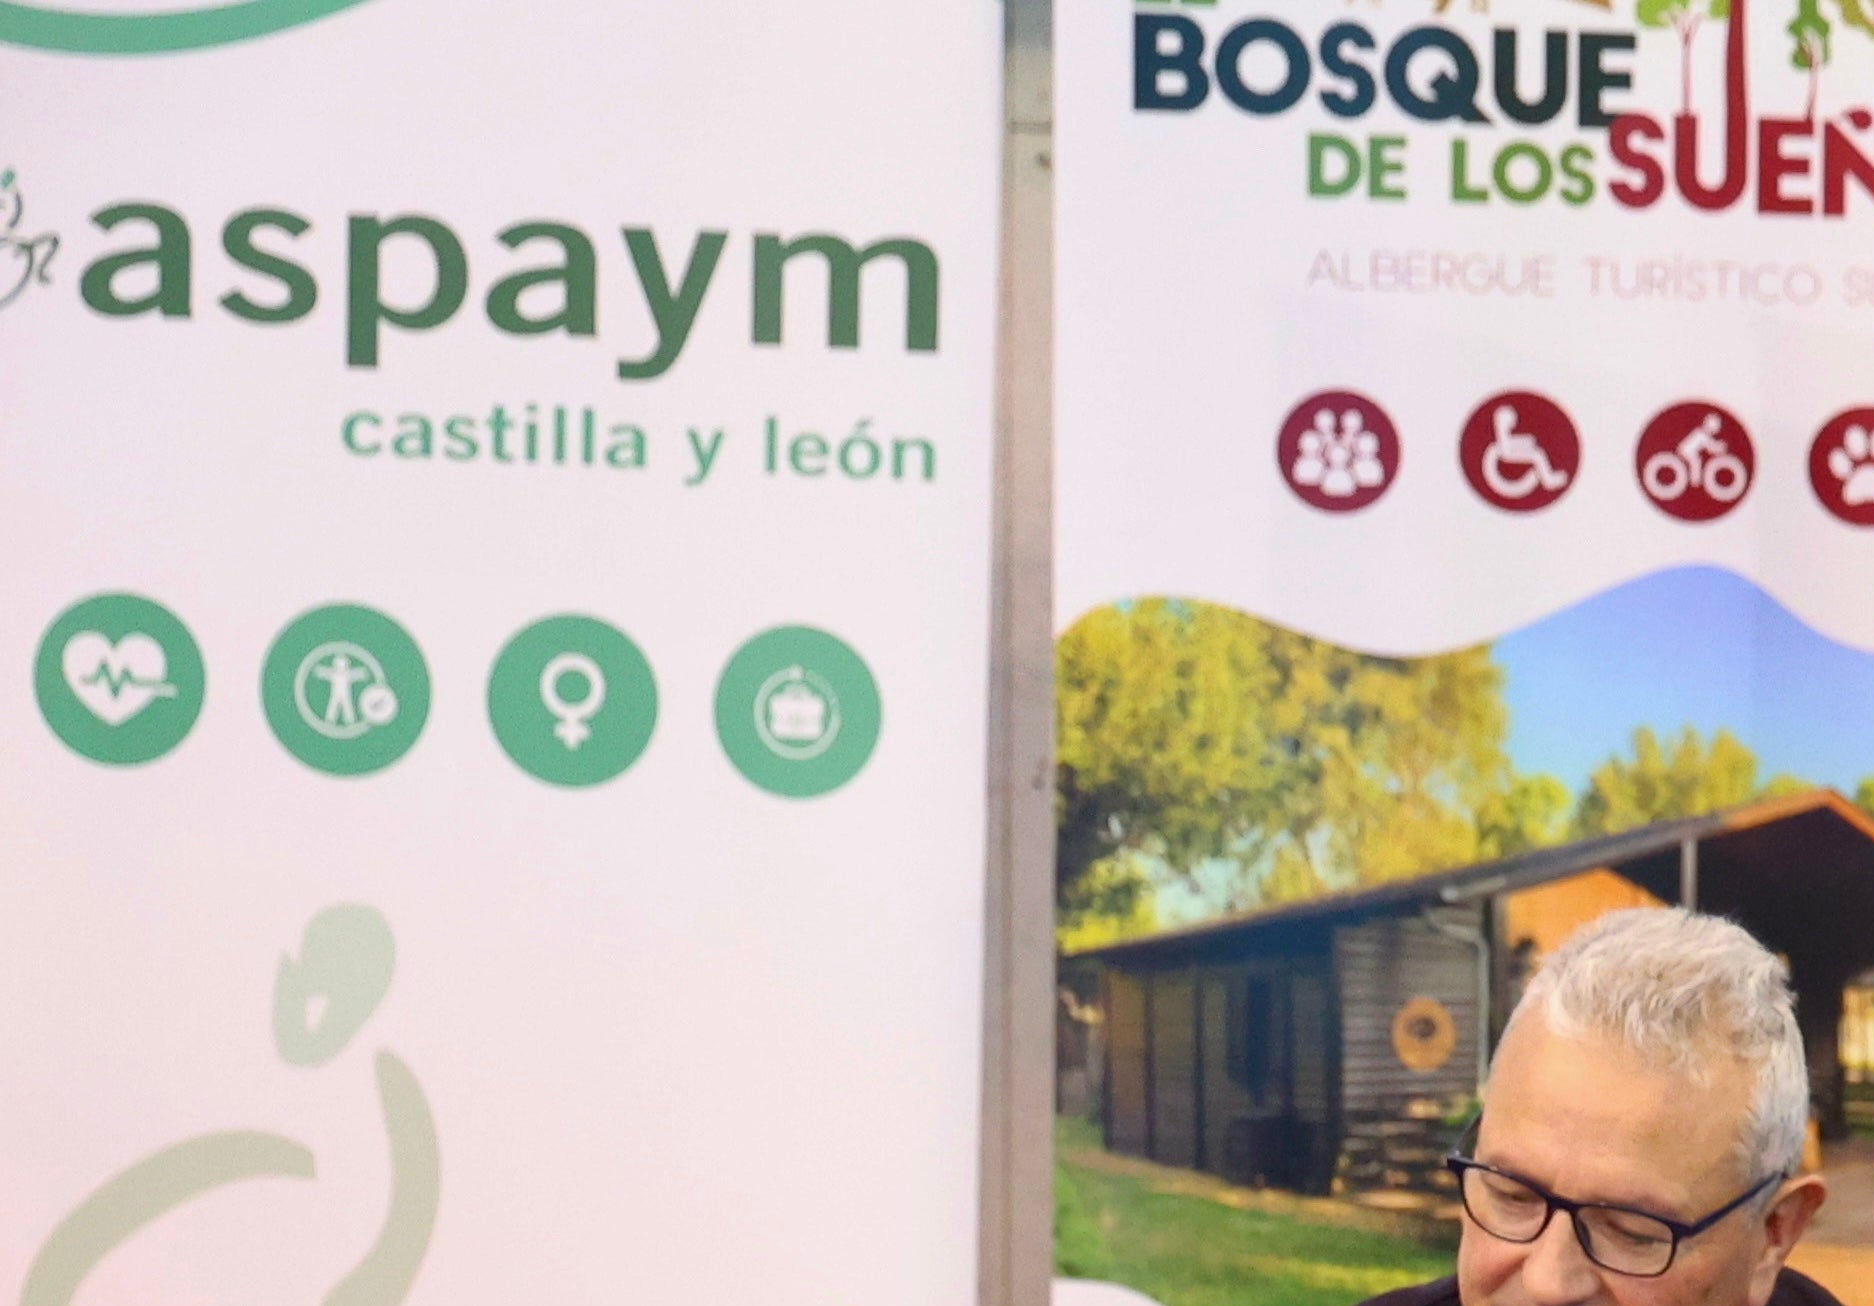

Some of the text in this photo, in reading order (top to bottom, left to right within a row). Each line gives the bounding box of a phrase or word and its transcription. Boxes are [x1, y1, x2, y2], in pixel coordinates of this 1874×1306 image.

[1133, 13, 1637, 127] BOSQUE
[1308, 133, 1408, 200] DE
[1452, 138, 1596, 206] LOS
[80, 200, 939, 380] aspaym
[1307, 248, 1556, 299] ALBERGUE
[1582, 248, 1822, 307] TURÍSTICO
[340, 403, 937, 486] castilla y león
